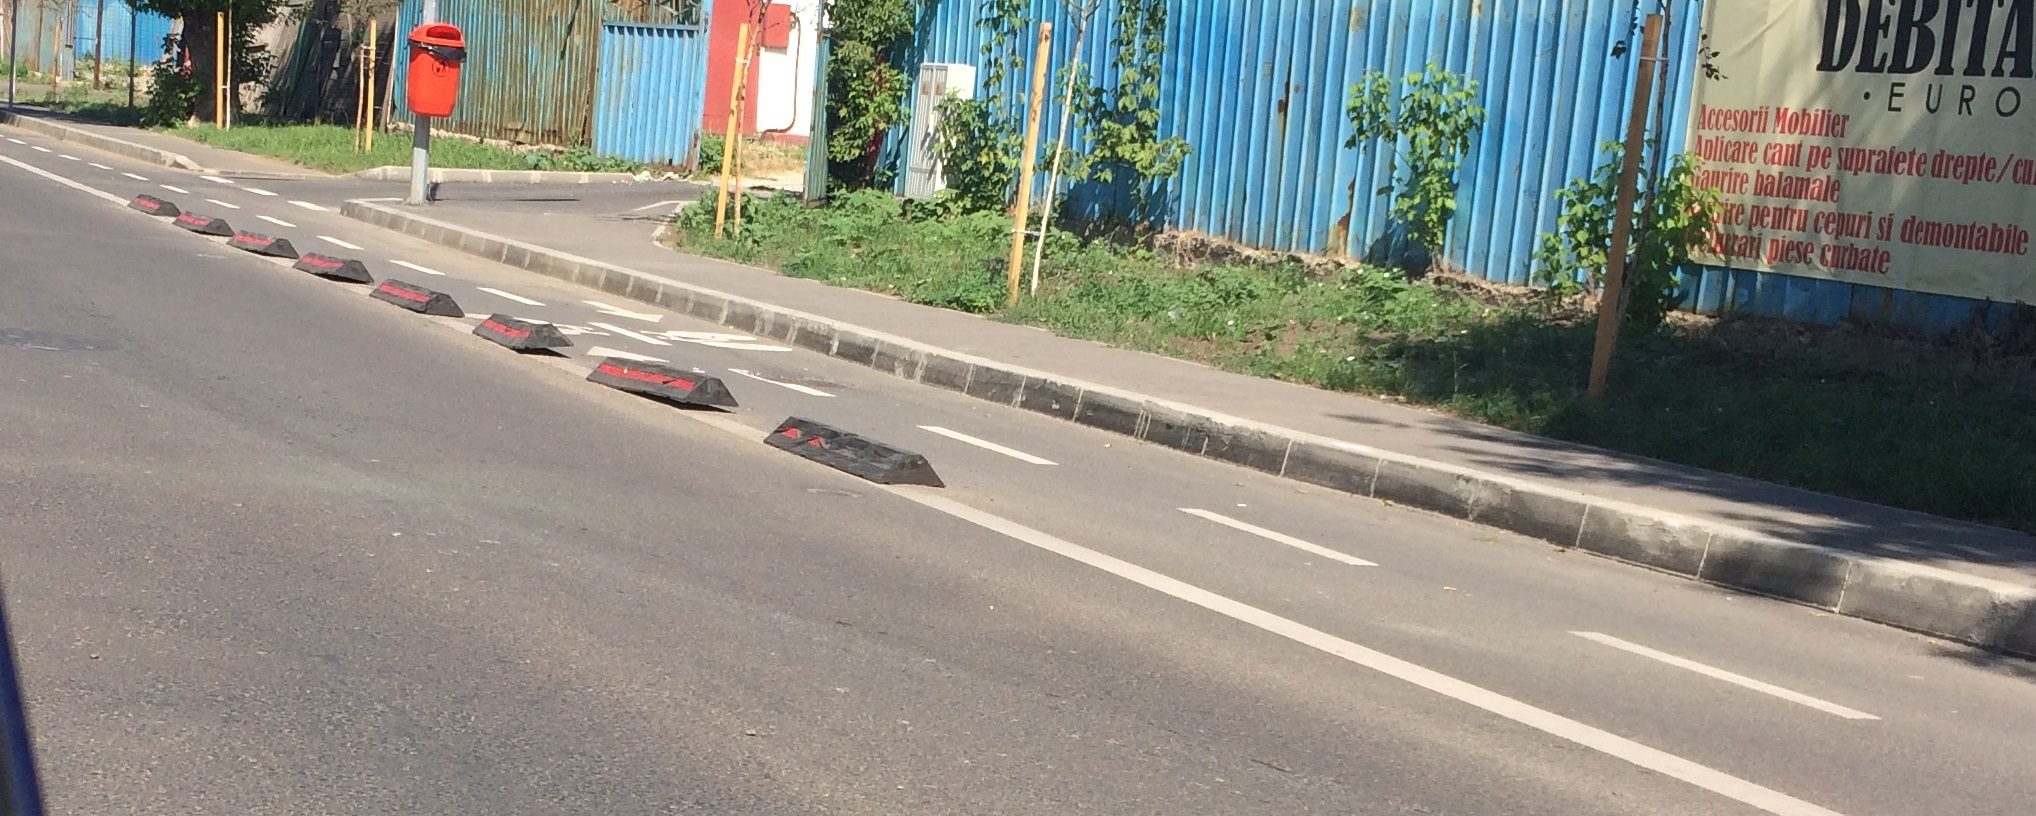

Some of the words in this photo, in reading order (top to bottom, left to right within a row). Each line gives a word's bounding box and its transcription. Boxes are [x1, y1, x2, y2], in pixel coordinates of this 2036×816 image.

[1816, 0, 2036, 78] DEBITA
[1697, 104, 1769, 133] Accesorii
[1772, 107, 1849, 138] Mobilier
[1694, 135, 1758, 164] Aplicare
[1763, 140, 1804, 167] cant
[1805, 145, 1832, 172] pe
[1837, 146, 1928, 176] suprafete
[1754, 169, 1840, 203] balamale
[1748, 204, 1808, 232] pentru
[1813, 210, 1873, 240] cepuri
[1876, 213, 1894, 241] si
[1900, 215, 2029, 256] demontabile
[1766, 235, 1814, 266] piese
[1819, 243, 1891, 275] curbate
